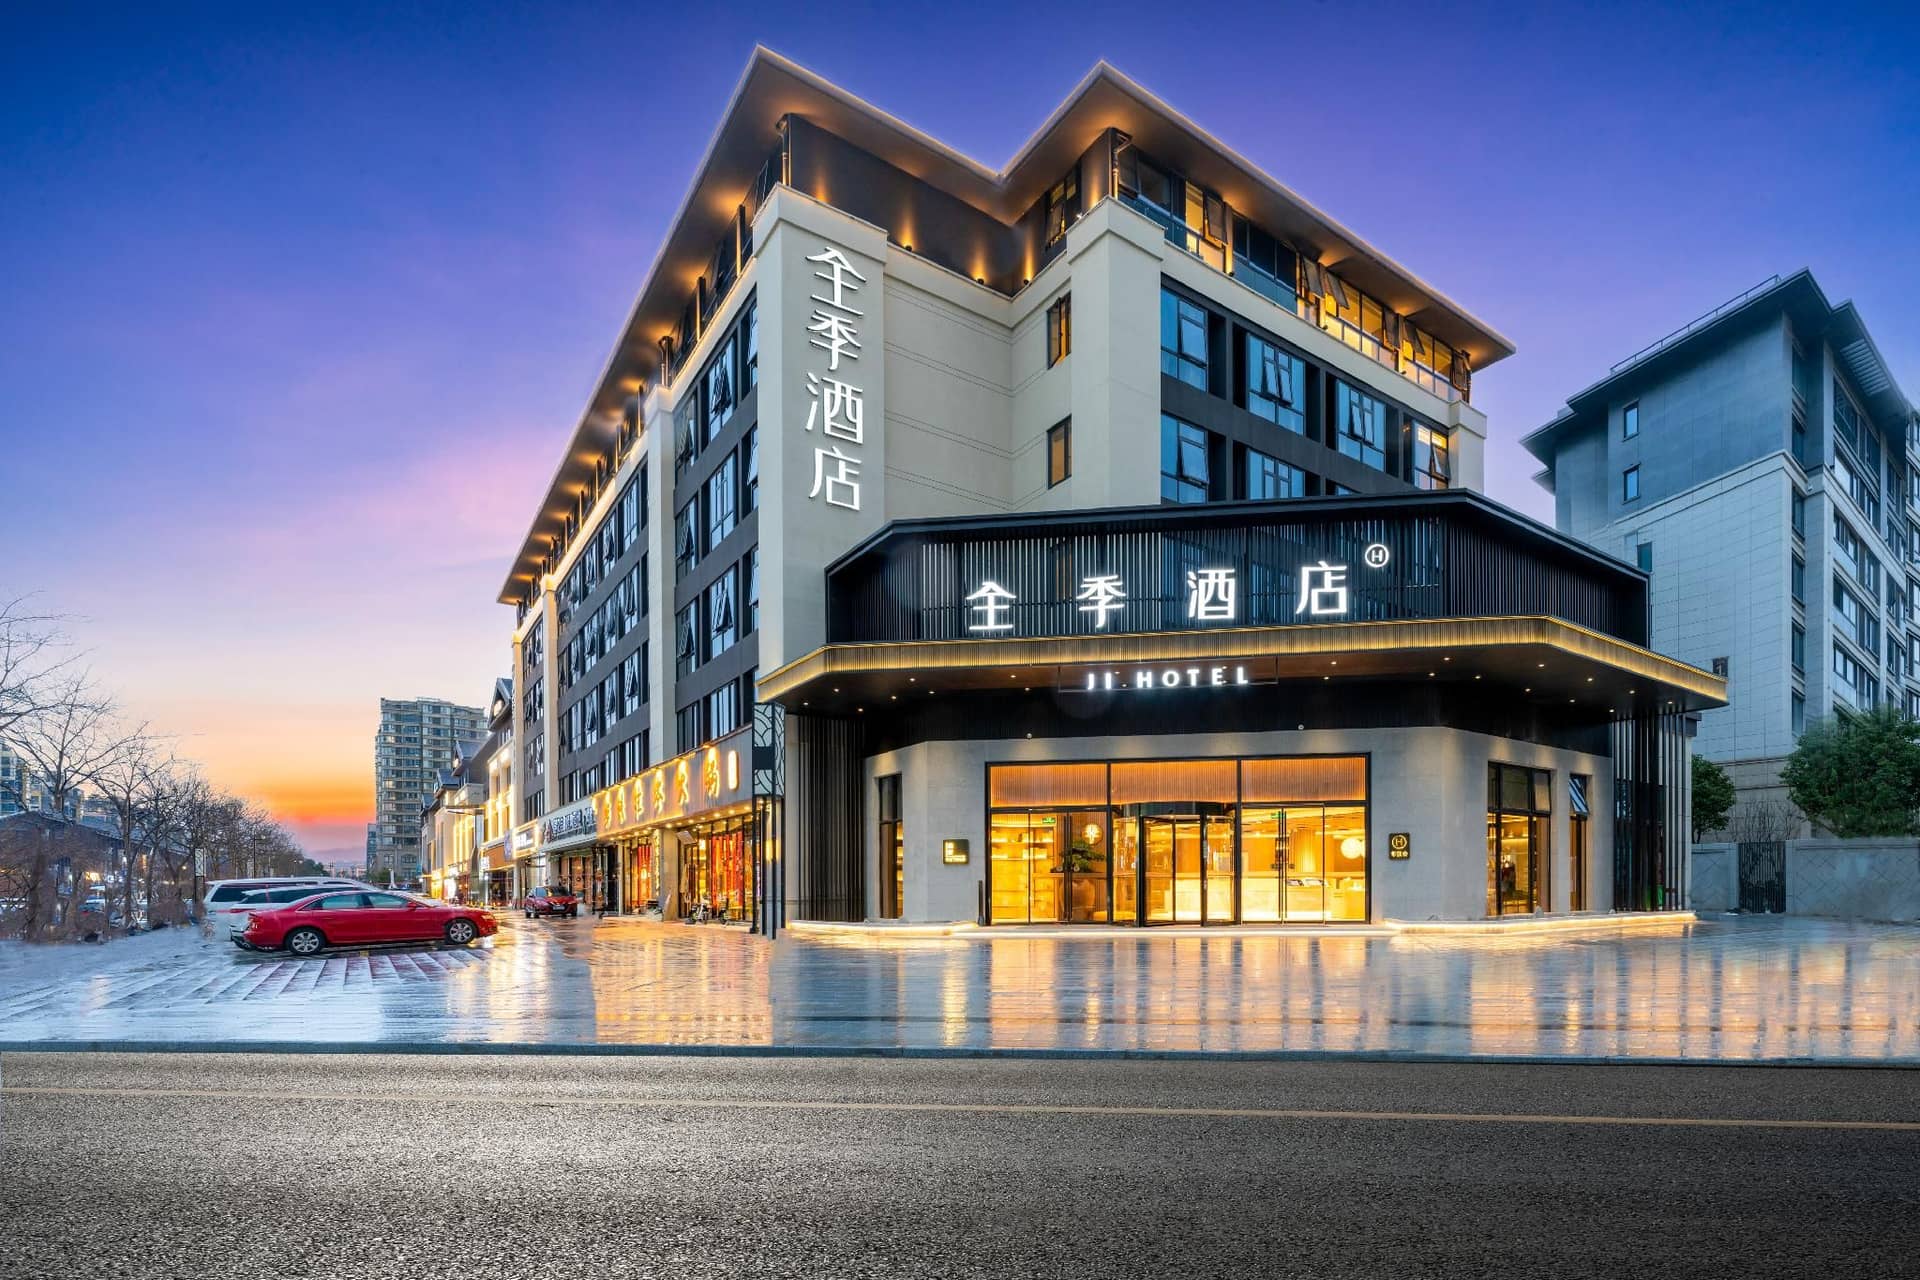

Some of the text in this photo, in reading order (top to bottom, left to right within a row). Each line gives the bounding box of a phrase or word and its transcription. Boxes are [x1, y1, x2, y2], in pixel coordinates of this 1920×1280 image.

[806, 247, 867, 511] 全季酒店
[966, 560, 1348, 631] 全季酒店
[1087, 666, 1249, 690] JI HOTEL
